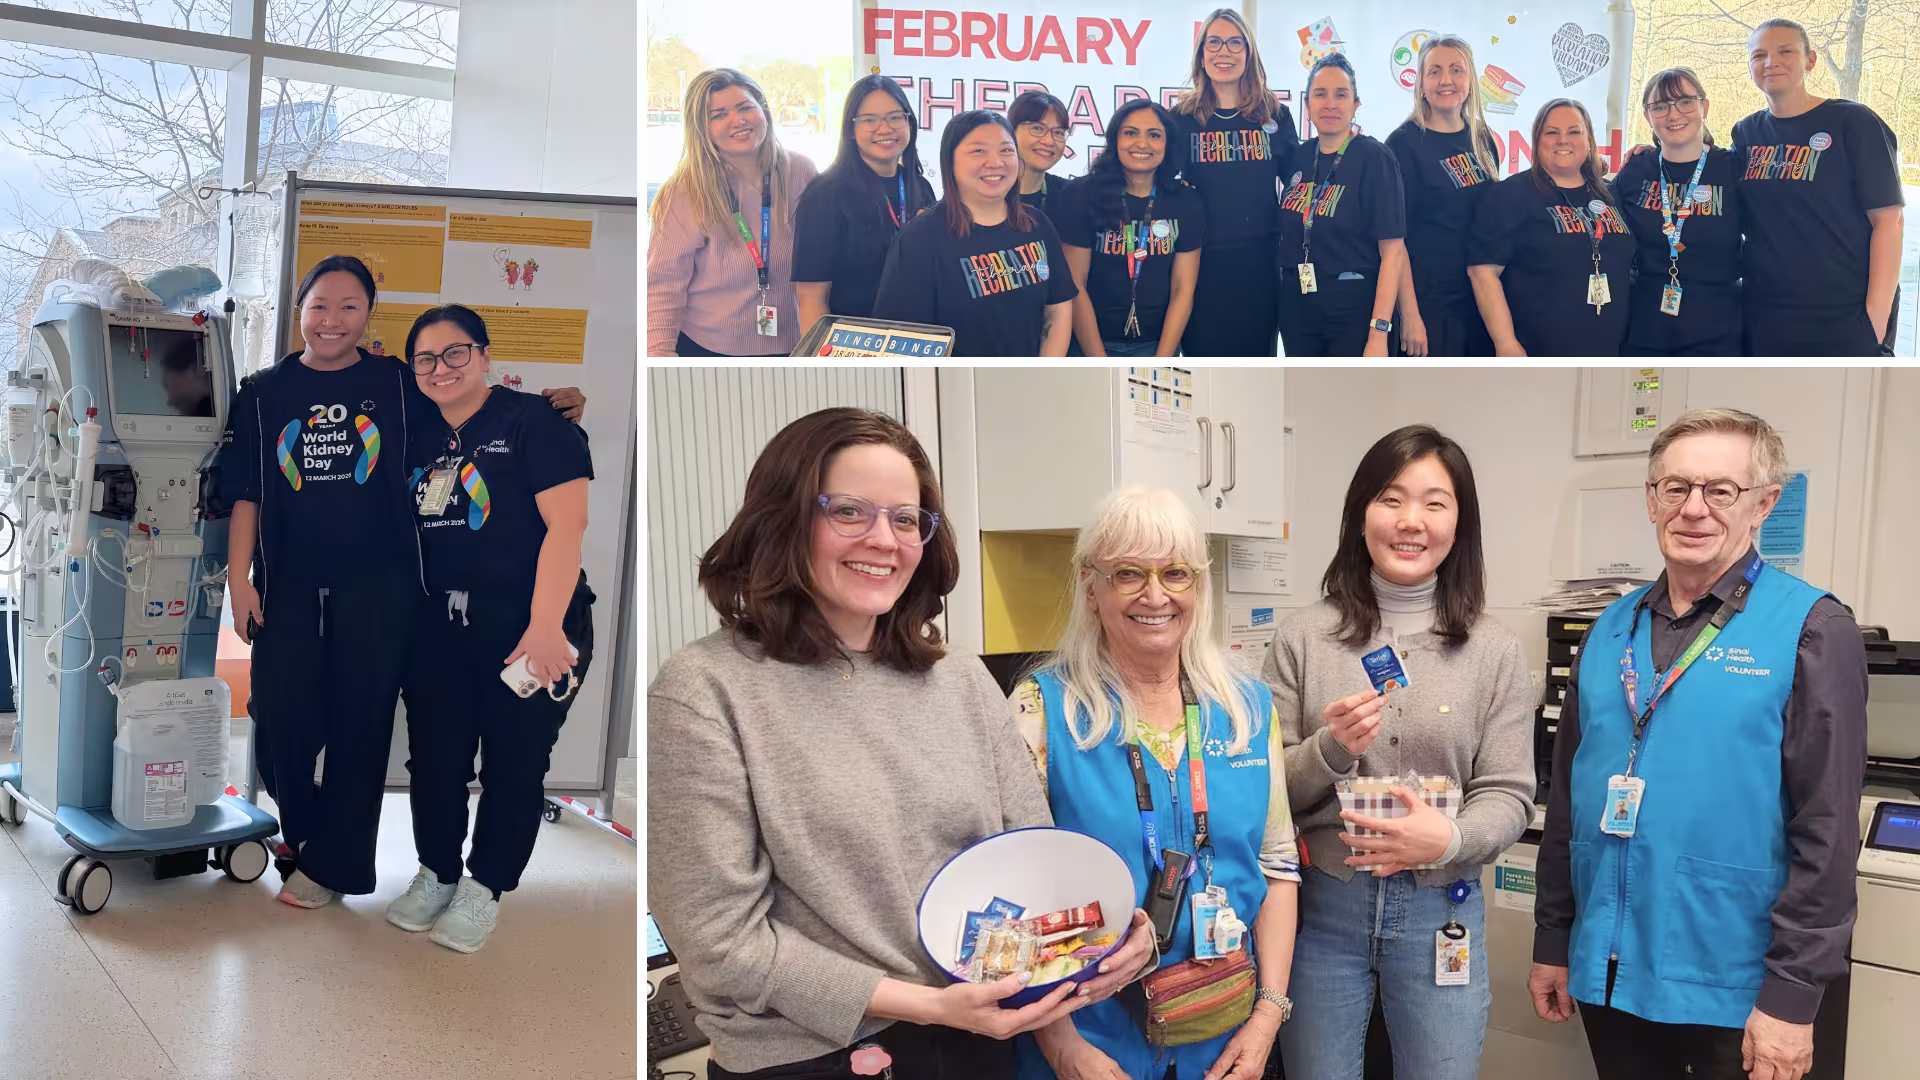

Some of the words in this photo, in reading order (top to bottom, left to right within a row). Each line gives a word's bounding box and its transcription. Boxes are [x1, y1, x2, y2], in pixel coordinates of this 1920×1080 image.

[863, 8, 1151, 66] FEBRUARY
[1191, 129, 1272, 163] RECREATION
[831, 332, 884, 350] BINGO
[888, 339, 943, 356] BINGO
[308, 403, 348, 425] 20
[302, 430, 347, 444] World
[303, 444, 354, 457] Kidney
[304, 457, 332, 471] Day
[1728, 647, 1750, 655] Sinai
[1726, 654, 1756, 664] Health
[1724, 665, 1771, 676] VOLUNTEER
